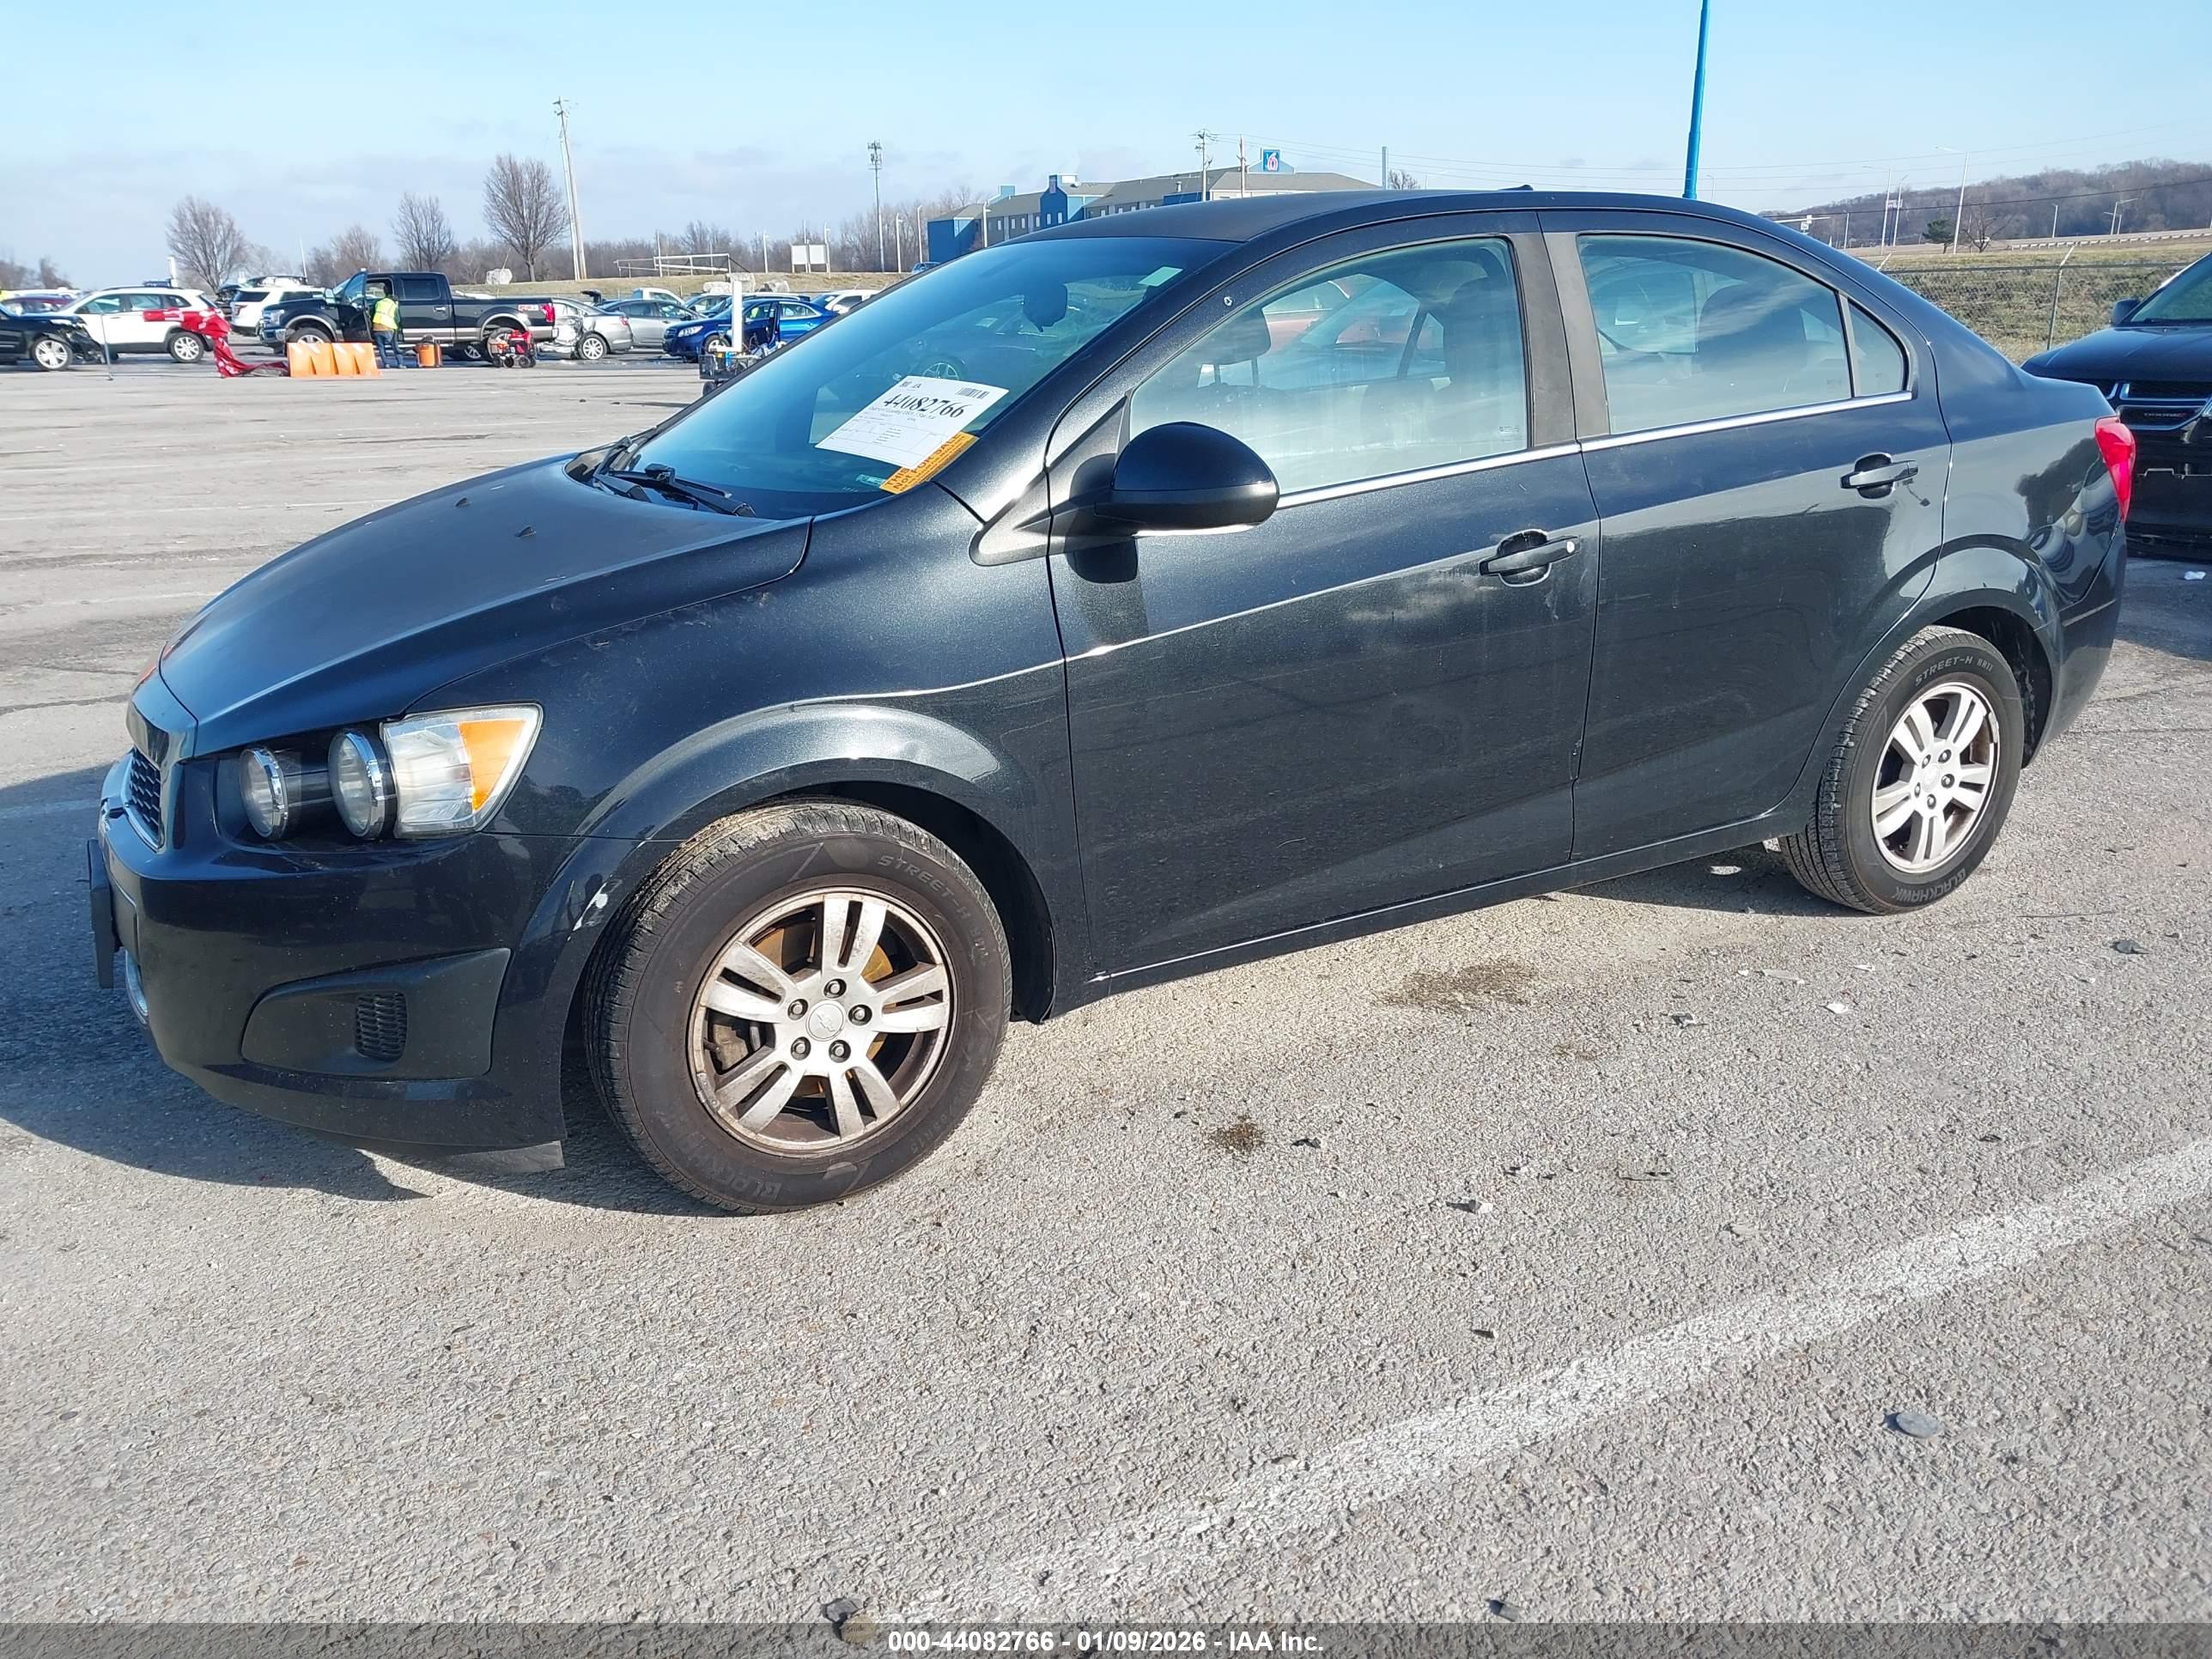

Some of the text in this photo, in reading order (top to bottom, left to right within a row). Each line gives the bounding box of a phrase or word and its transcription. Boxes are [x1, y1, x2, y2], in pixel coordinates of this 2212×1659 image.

[1267, 151, 1279, 171] 6
[884, 392, 972, 418] 44082766
[884, 468, 911, 486] THIS
[892, 475, 912, 489] Not
[911, 455, 935, 474] FOR
[1915, 655, 1973, 687] STREET-H
[878, 854, 971, 918] STREET-H
[1895, 867, 1966, 902] BLACKHAWK
